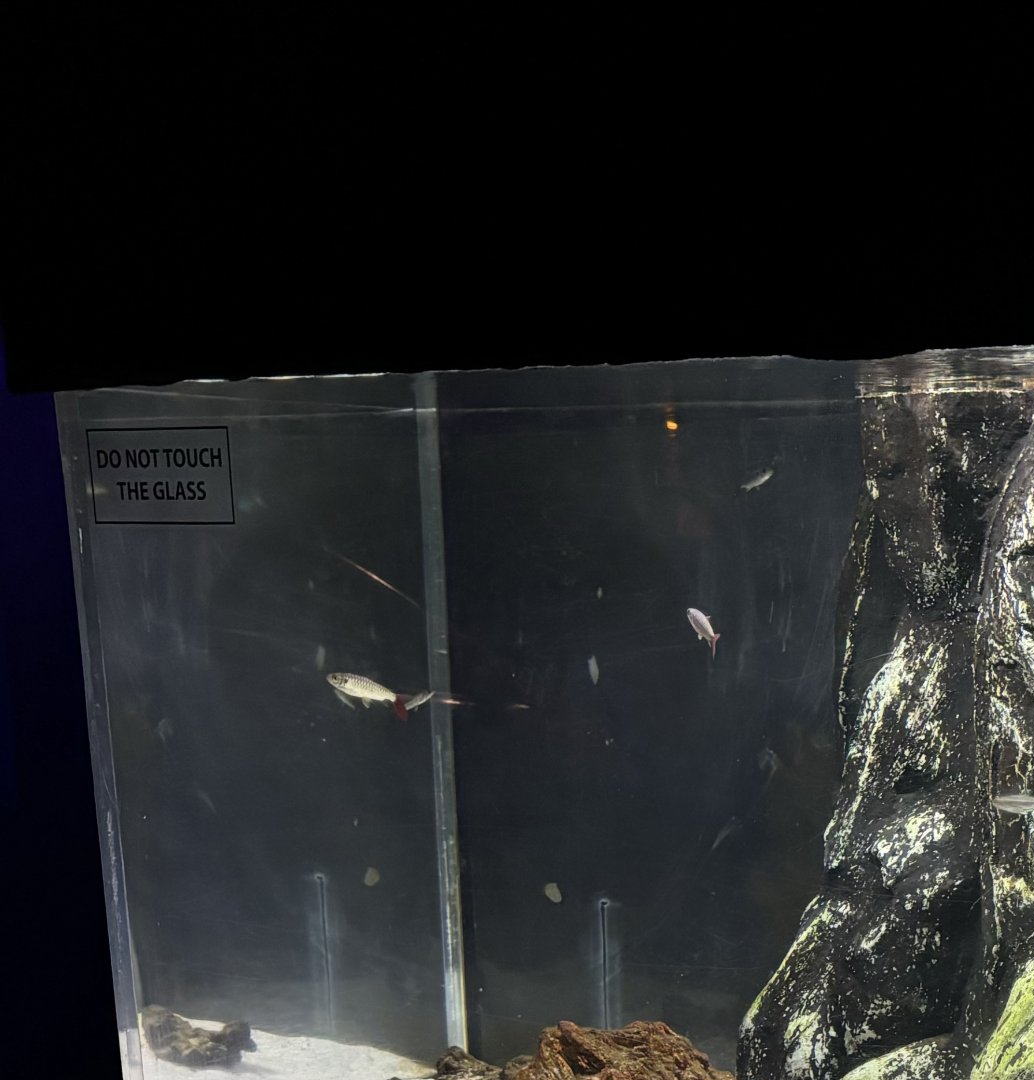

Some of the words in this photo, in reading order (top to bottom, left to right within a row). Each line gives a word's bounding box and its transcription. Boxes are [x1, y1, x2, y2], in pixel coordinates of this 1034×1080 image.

[96, 449, 121, 468] DO
[125, 449, 159, 468] NOT
[162, 448, 222, 468] TOUCH
[116, 481, 149, 500] THE
[153, 481, 206, 500] GLASS
